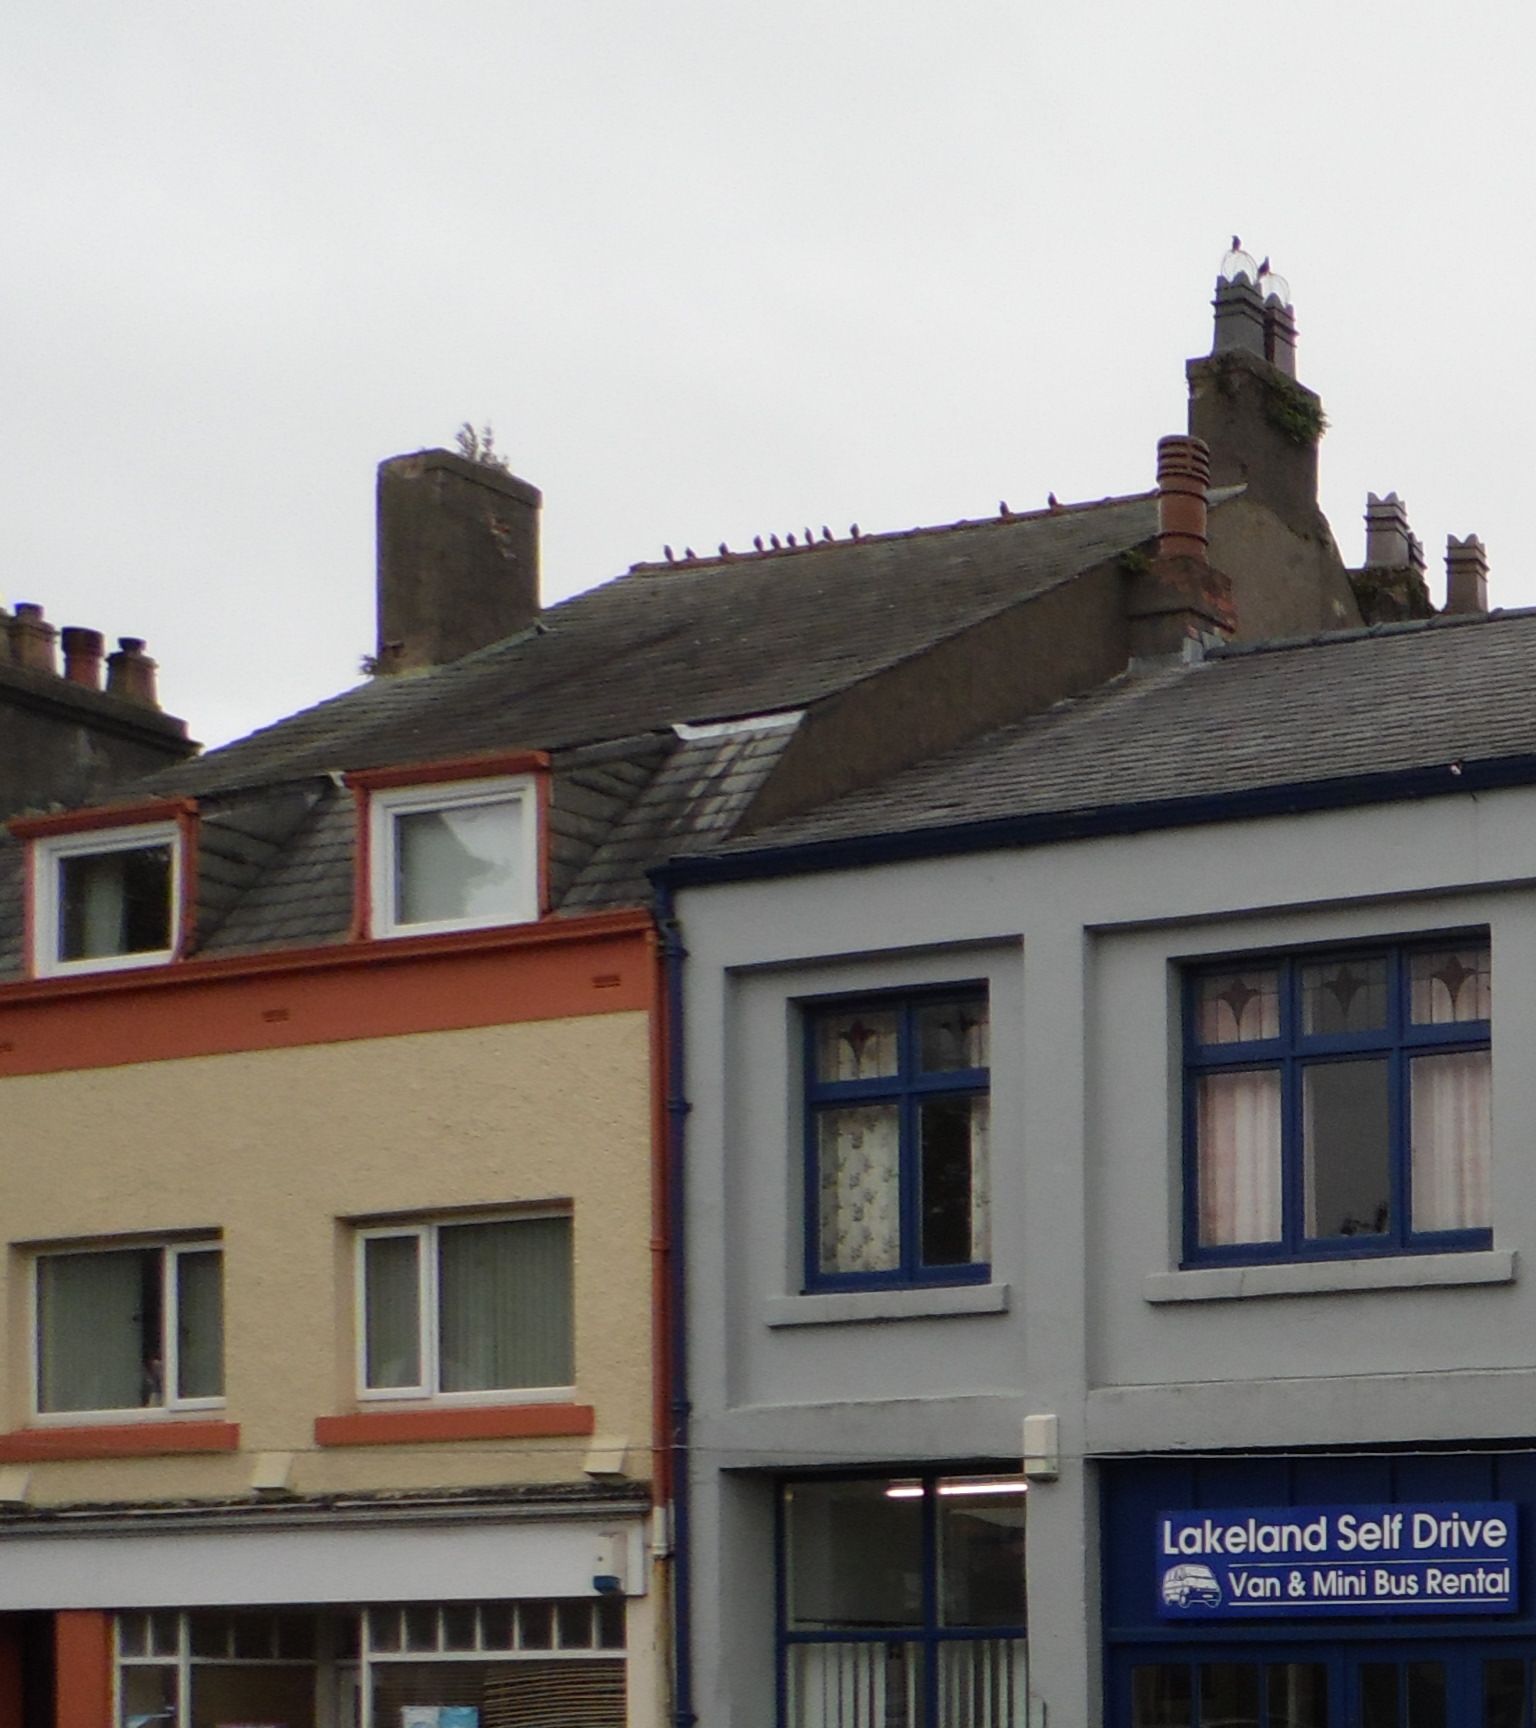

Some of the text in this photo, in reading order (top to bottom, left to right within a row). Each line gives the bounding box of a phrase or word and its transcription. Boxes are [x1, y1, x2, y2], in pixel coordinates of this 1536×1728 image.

[1162, 1511, 1509, 1556] Lakeland Self Drive
[1228, 1566, 1511, 1599] Van & Mini Bus Rental
